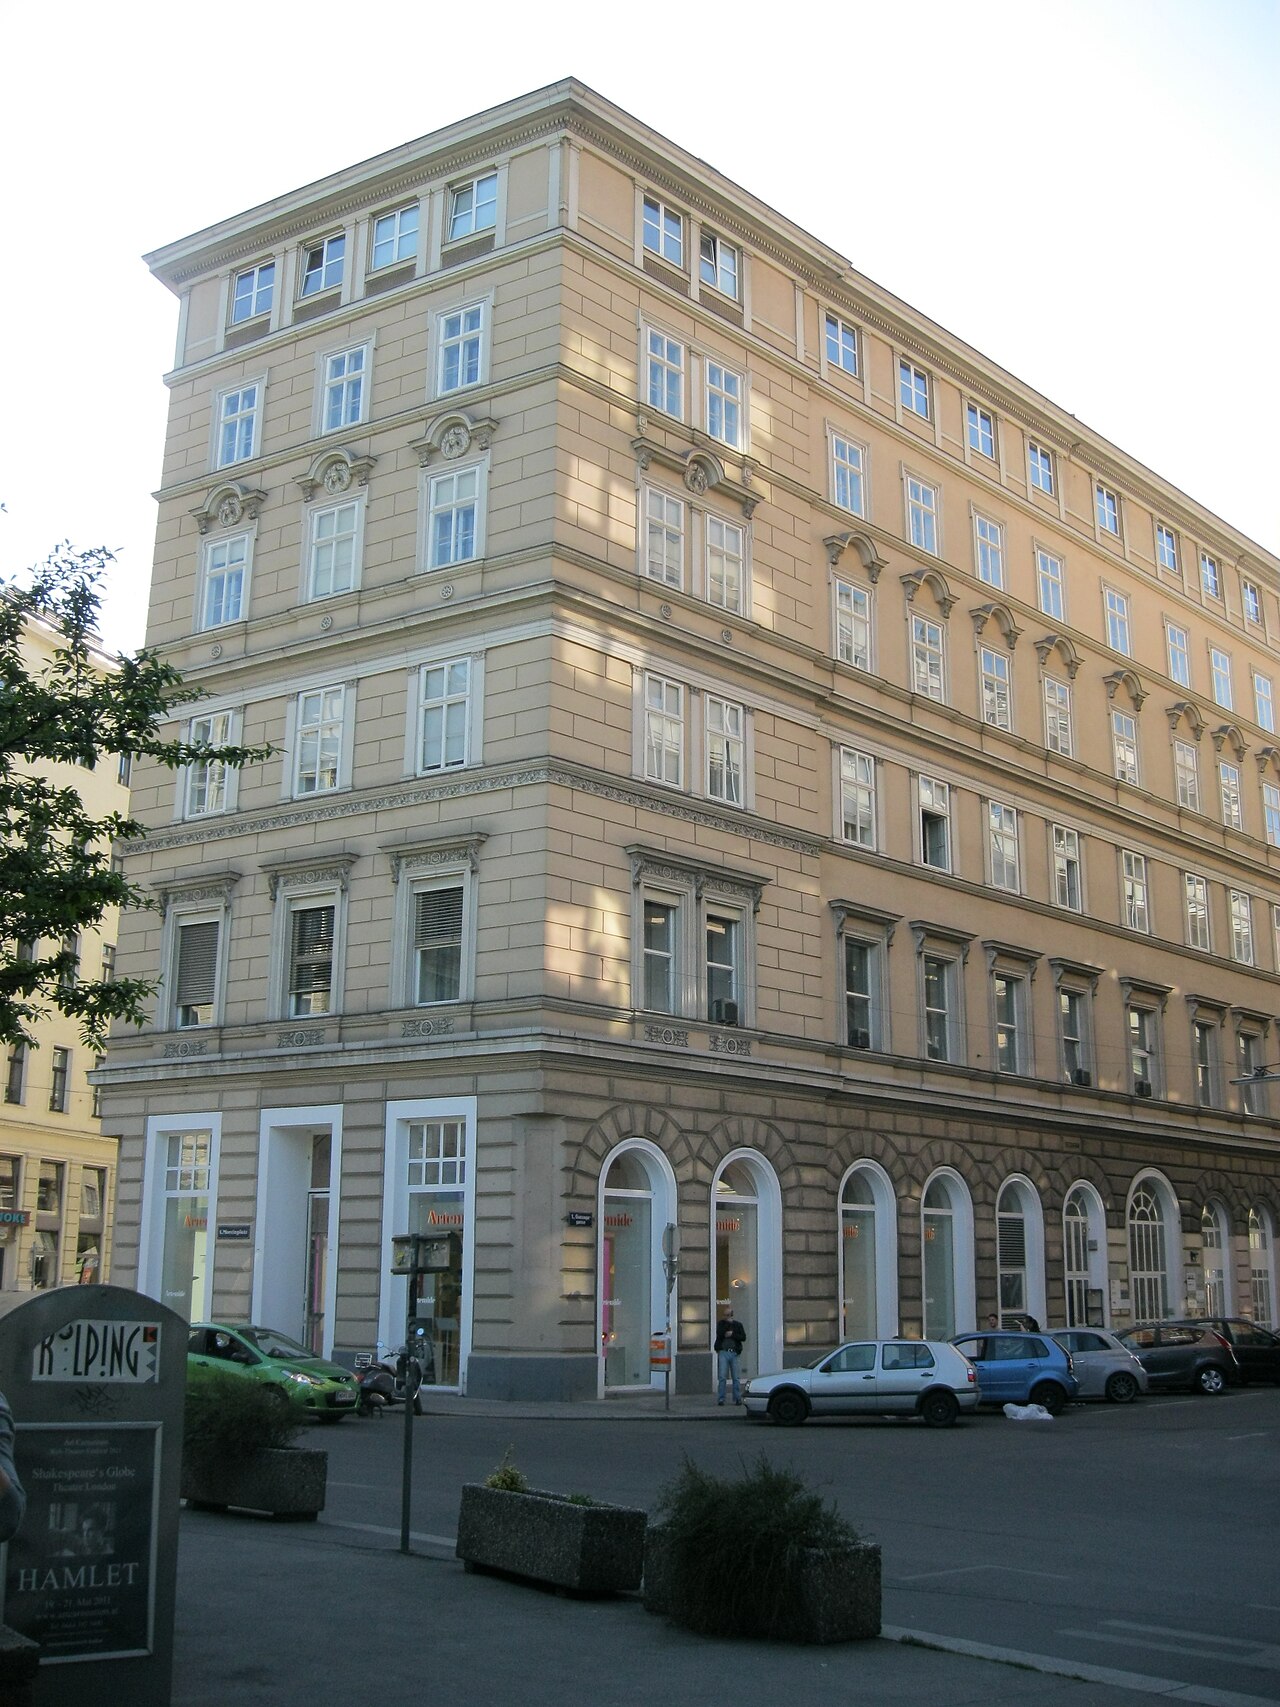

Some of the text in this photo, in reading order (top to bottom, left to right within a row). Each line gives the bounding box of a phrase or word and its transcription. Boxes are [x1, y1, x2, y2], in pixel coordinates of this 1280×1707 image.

[32, 1466, 136, 1481] Shakespeare's Globe
[18, 1562, 139, 1591] HAMLET
